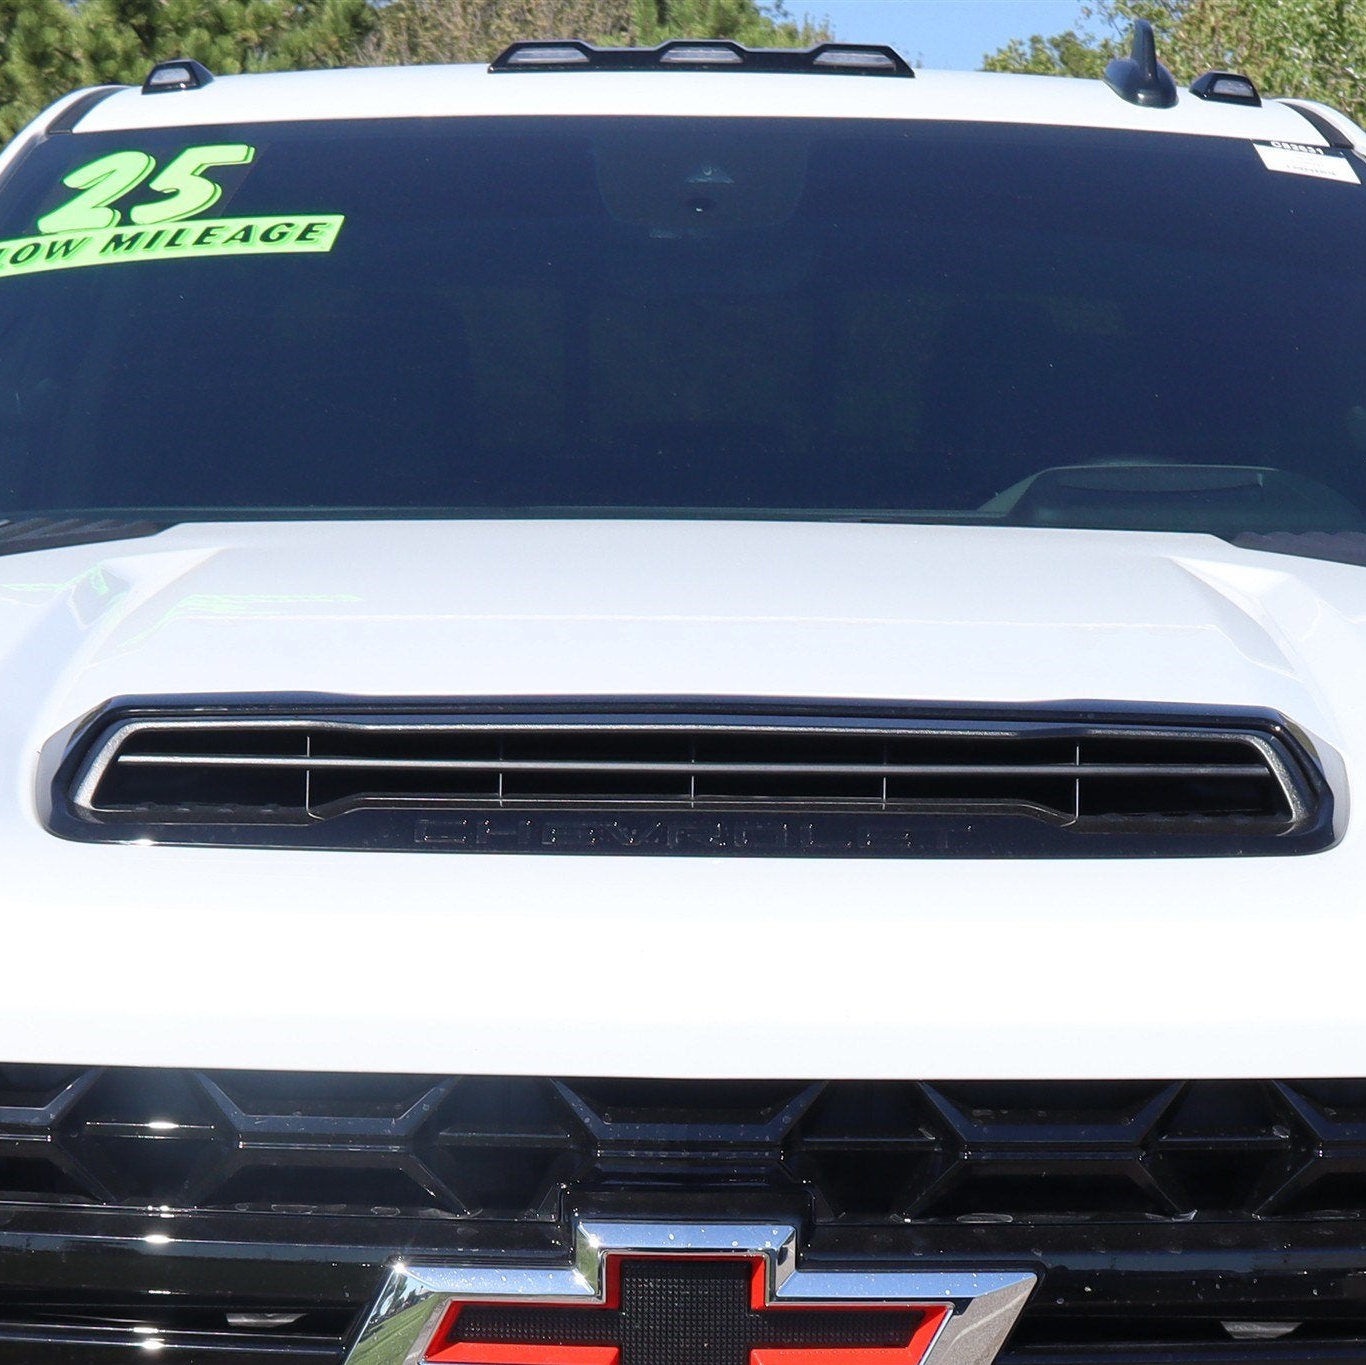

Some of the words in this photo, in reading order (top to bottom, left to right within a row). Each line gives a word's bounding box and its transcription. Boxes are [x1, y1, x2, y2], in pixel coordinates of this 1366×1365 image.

[37, 143, 255, 234] 25
[99, 220, 332, 256] MILEAGE
[413, 819, 972, 850] CHEVROLET
